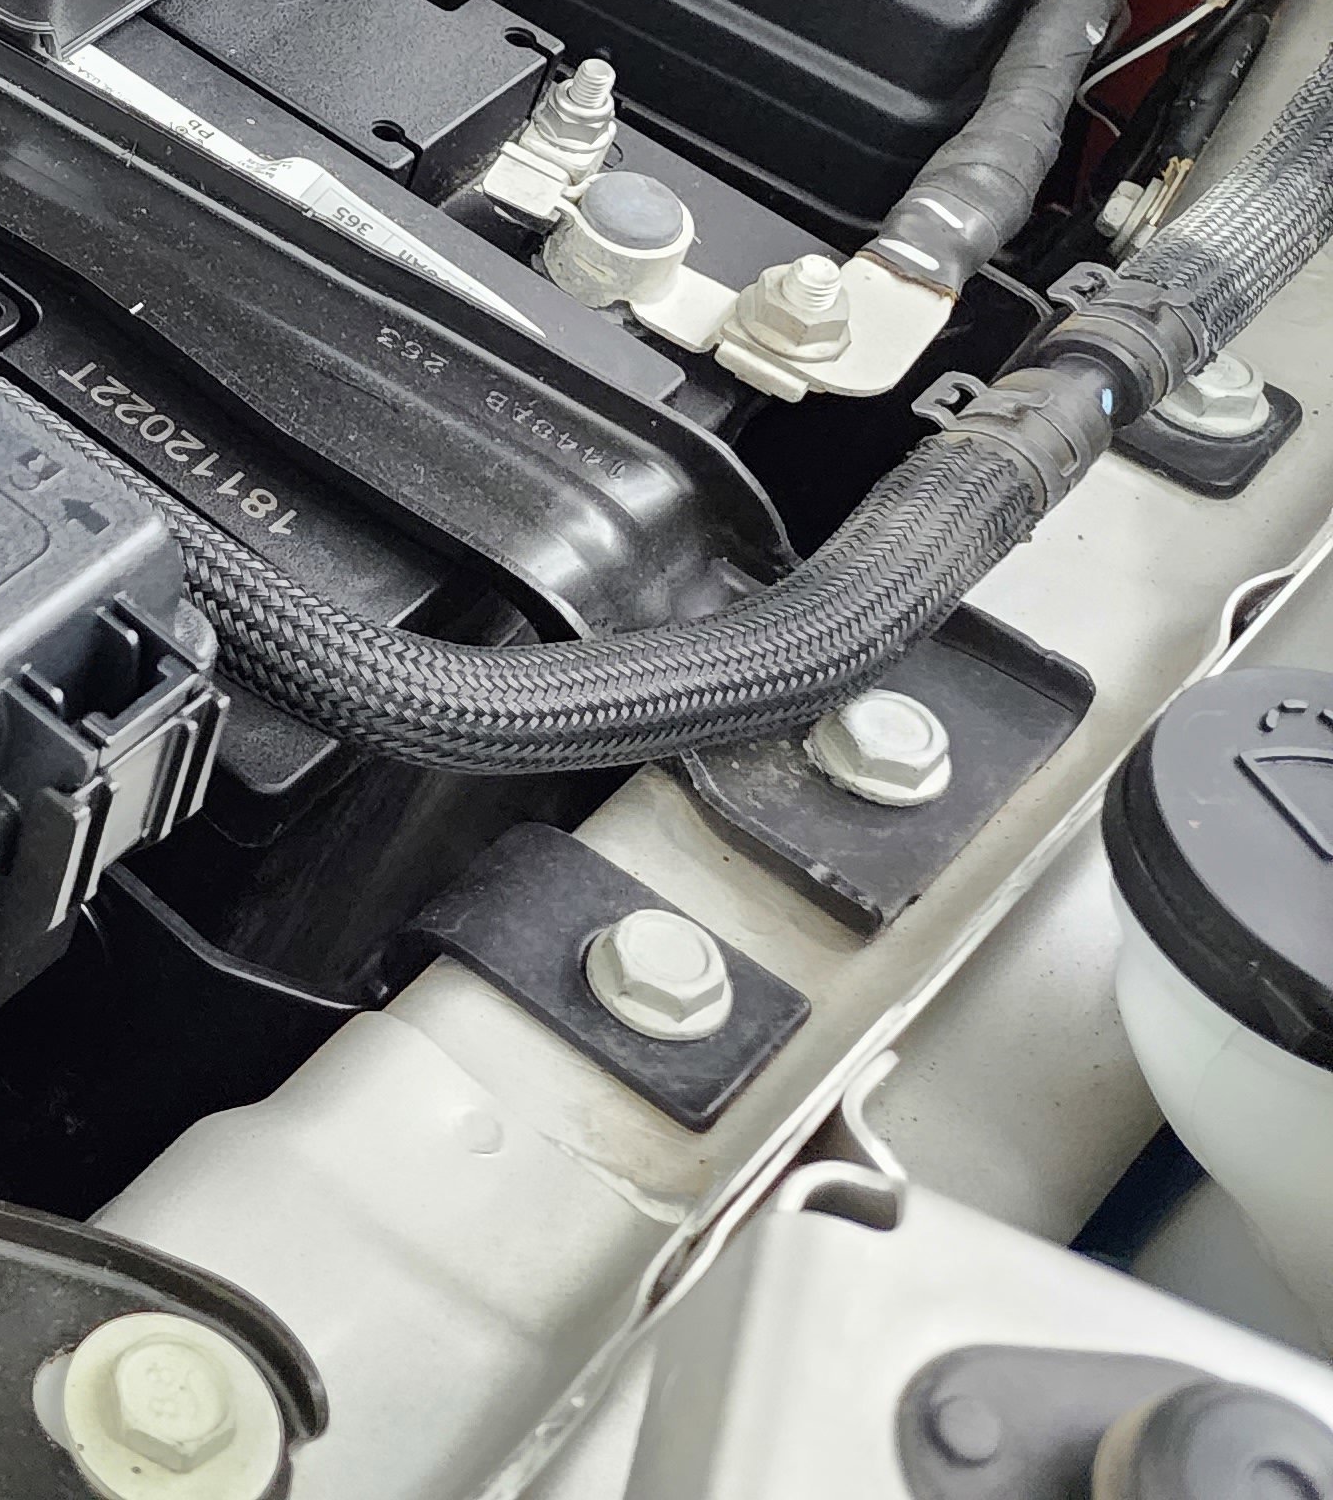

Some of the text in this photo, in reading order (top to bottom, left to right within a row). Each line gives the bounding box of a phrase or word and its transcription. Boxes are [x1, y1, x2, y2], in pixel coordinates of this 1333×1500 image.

[188, 117, 215, 141] Pb
[332, 206, 374, 237] 365
[374, 324, 450, 375] 263
[56, 361, 297, 535] 18112022T
